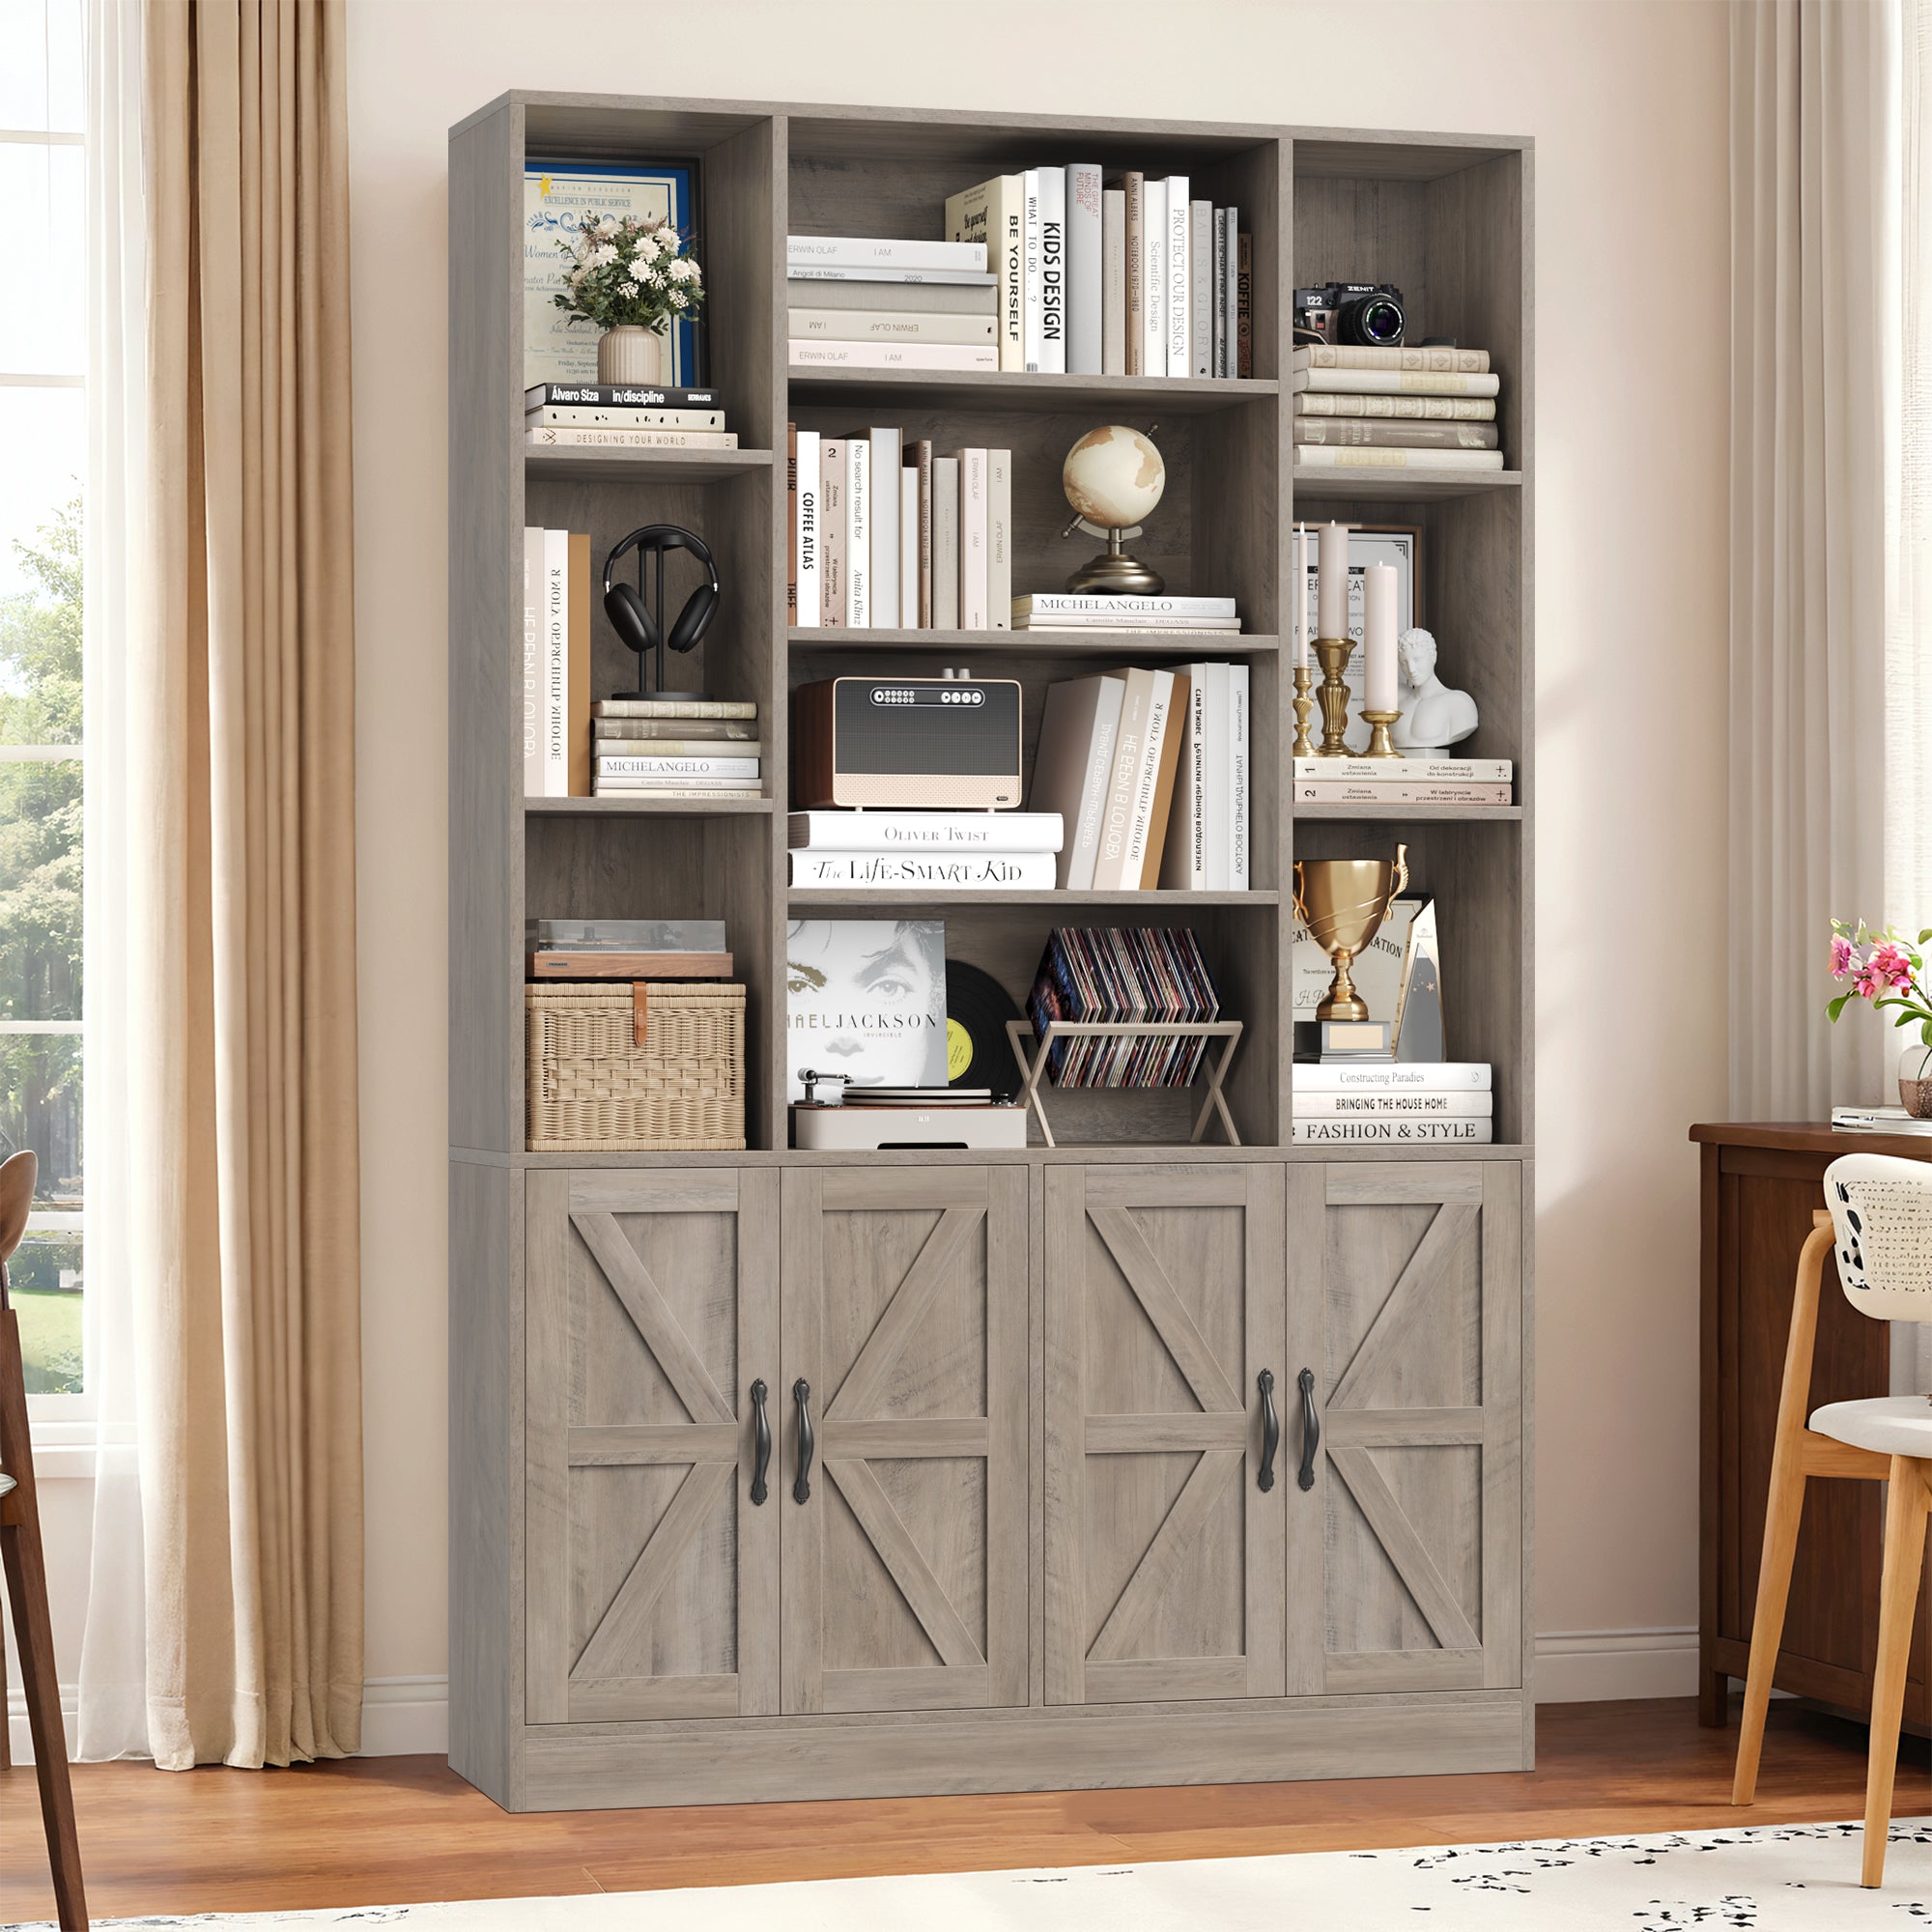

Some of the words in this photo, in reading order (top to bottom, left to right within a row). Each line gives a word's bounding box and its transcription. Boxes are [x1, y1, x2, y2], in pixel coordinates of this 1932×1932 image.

[545, 196, 580, 206] EXCELLENCE
[581, 197, 587, 206] IN
[588, 197, 607, 207] PUBLIC
[609, 198, 631, 208] SERVICE
[1085, 201, 1092, 213] OF
[1028, 196, 1037, 226] WHAT
[1009, 215, 1019, 238] BE
[1028, 236, 1037, 250] TO
[1043, 222, 1061, 265] KIDS
[1173, 209, 1185, 269] PROTECT
[788, 245, 814, 254] ERWIN
[816, 245, 838, 254] OLAF
[878, 248, 892, 257] AM
[1151, 241, 1160, 292] Scientific
[1009, 245, 1019, 341] YOURSELF
[1173, 273, 1184, 307] OUR
[1237, 272, 1250, 320] KOFFIE
[1043, 271, 1061, 339] DESIGN
[1306, 296, 1321, 305] 122
[1149, 295, 1160, 332] Design
[809, 321, 822, 329] AM
[893, 324, 919, 332] ERWIN
[1172, 307, 1184, 356] DESIGN
[1197, 294, 1208, 360] GLORY
[552, 386, 580, 401] Álvaro
[581, 389, 599, 402] Siza
[612, 389, 665, 405] in/discipline
[577, 434, 625, 443] DESIGNING
[629, 436, 652, 444] YOUR
[656, 437, 686, 445] WORLD
[828, 448, 837, 458] 2
[855, 445, 863, 459] No
[854, 461, 863, 495] search
[997, 468, 1003, 479] AM
[803, 492, 814, 532] COFFEE
[854, 497, 863, 524] result
[854, 526, 863, 539] for
[973, 535, 979, 548] AM
[803, 536, 814, 570] ATLAS
[854, 570, 863, 597] Anita
[854, 600, 863, 626] Klinz
[1041, 599, 1173, 611] MICHELANGELO
[607, 761, 710, 773] MICHELANGELO
[813, 860, 847, 879] The
[1340, 1071, 1390, 1086] Constructing
[1392, 1071, 1425, 1083] Paradies
[1336, 1098, 1376, 1110] BRINGING
[1378, 1098, 1393, 1110] THE
[1396, 1098, 1422, 1110] HOUSE
[1425, 1098, 1447, 1110] HOME
[1307, 1124, 1391, 1139] FASHION
[1398, 1124, 1411, 1138] &
[1417, 1123, 1476, 1138] STYLE
